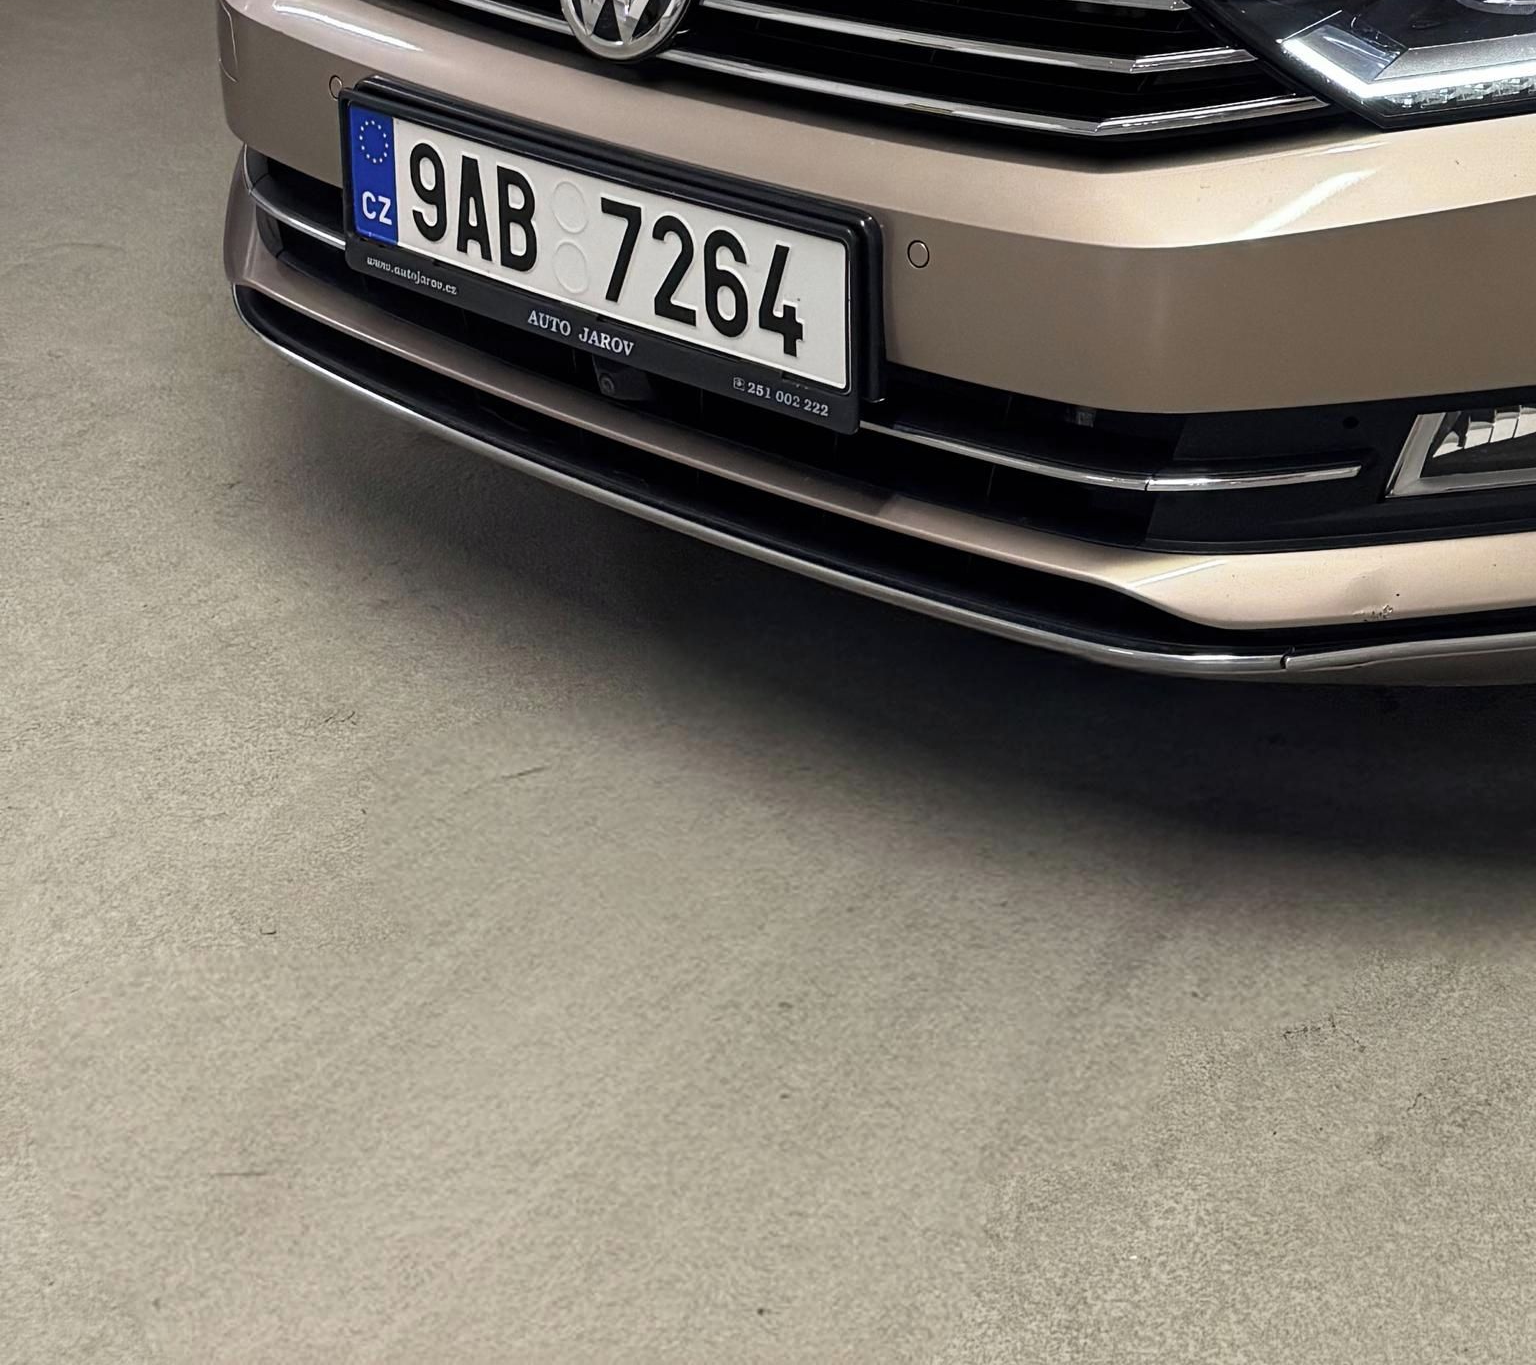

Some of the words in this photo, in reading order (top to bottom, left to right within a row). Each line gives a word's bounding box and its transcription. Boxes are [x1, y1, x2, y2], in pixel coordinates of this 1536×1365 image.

[361, 190, 393, 227] CZ
[409, 142, 538, 272] 9AB
[600, 196, 804, 358] 7264
[366, 256, 457, 295] www.autojarov.cz
[527, 309, 572, 337] AUTO
[578, 327, 635, 357] JAROV
[747, 381, 772, 400] 251
[775, 390, 800, 409] 002
[802, 398, 830, 417] 222
